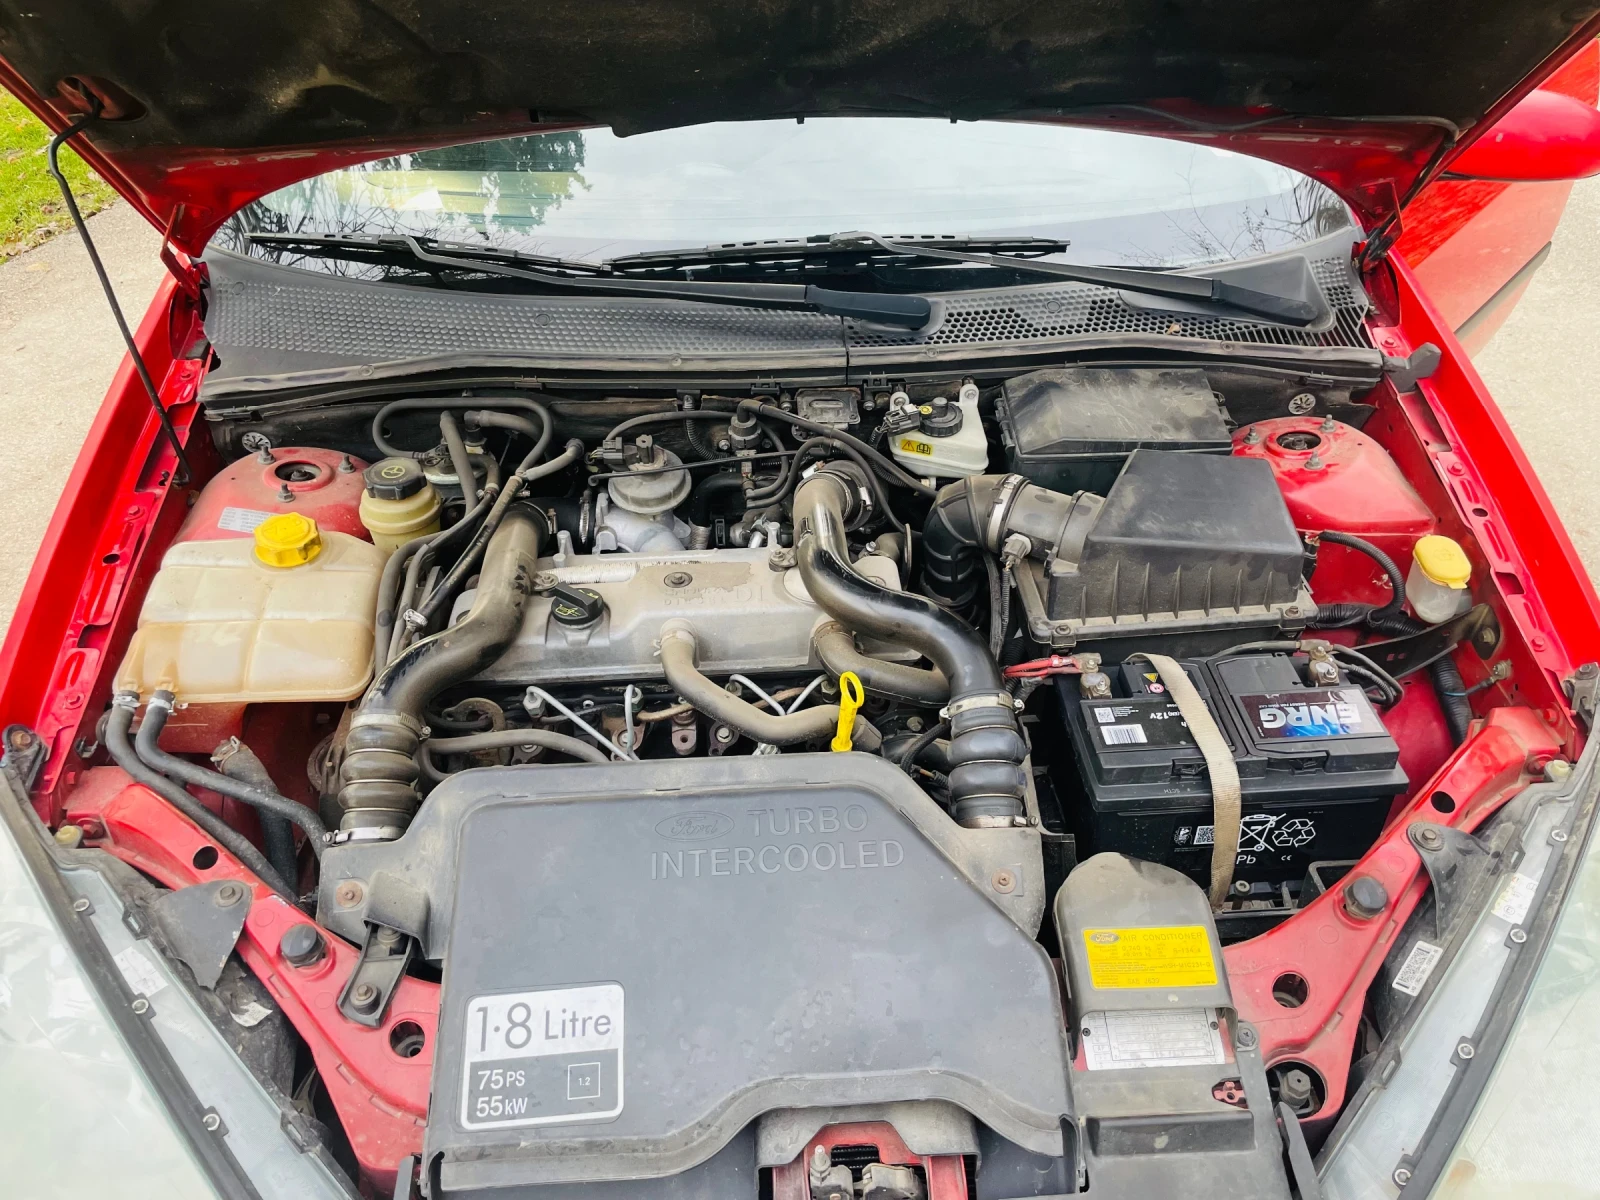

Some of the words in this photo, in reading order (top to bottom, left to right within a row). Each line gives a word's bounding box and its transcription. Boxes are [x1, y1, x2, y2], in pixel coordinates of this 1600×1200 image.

[1259, 705, 1362, 728] ENRG
[670, 816, 719, 836] Ford
[747, 804, 868, 837] TURBO
[651, 839, 905, 880] INTERCOOLED
[1236, 855, 1256, 865] Pb
[1095, 933, 1115, 942] Ford
[1143, 932, 1203, 941] CONDITIONER
[545, 1008, 611, 1040] Litre
[578, 1077, 591, 1086] 1.2
